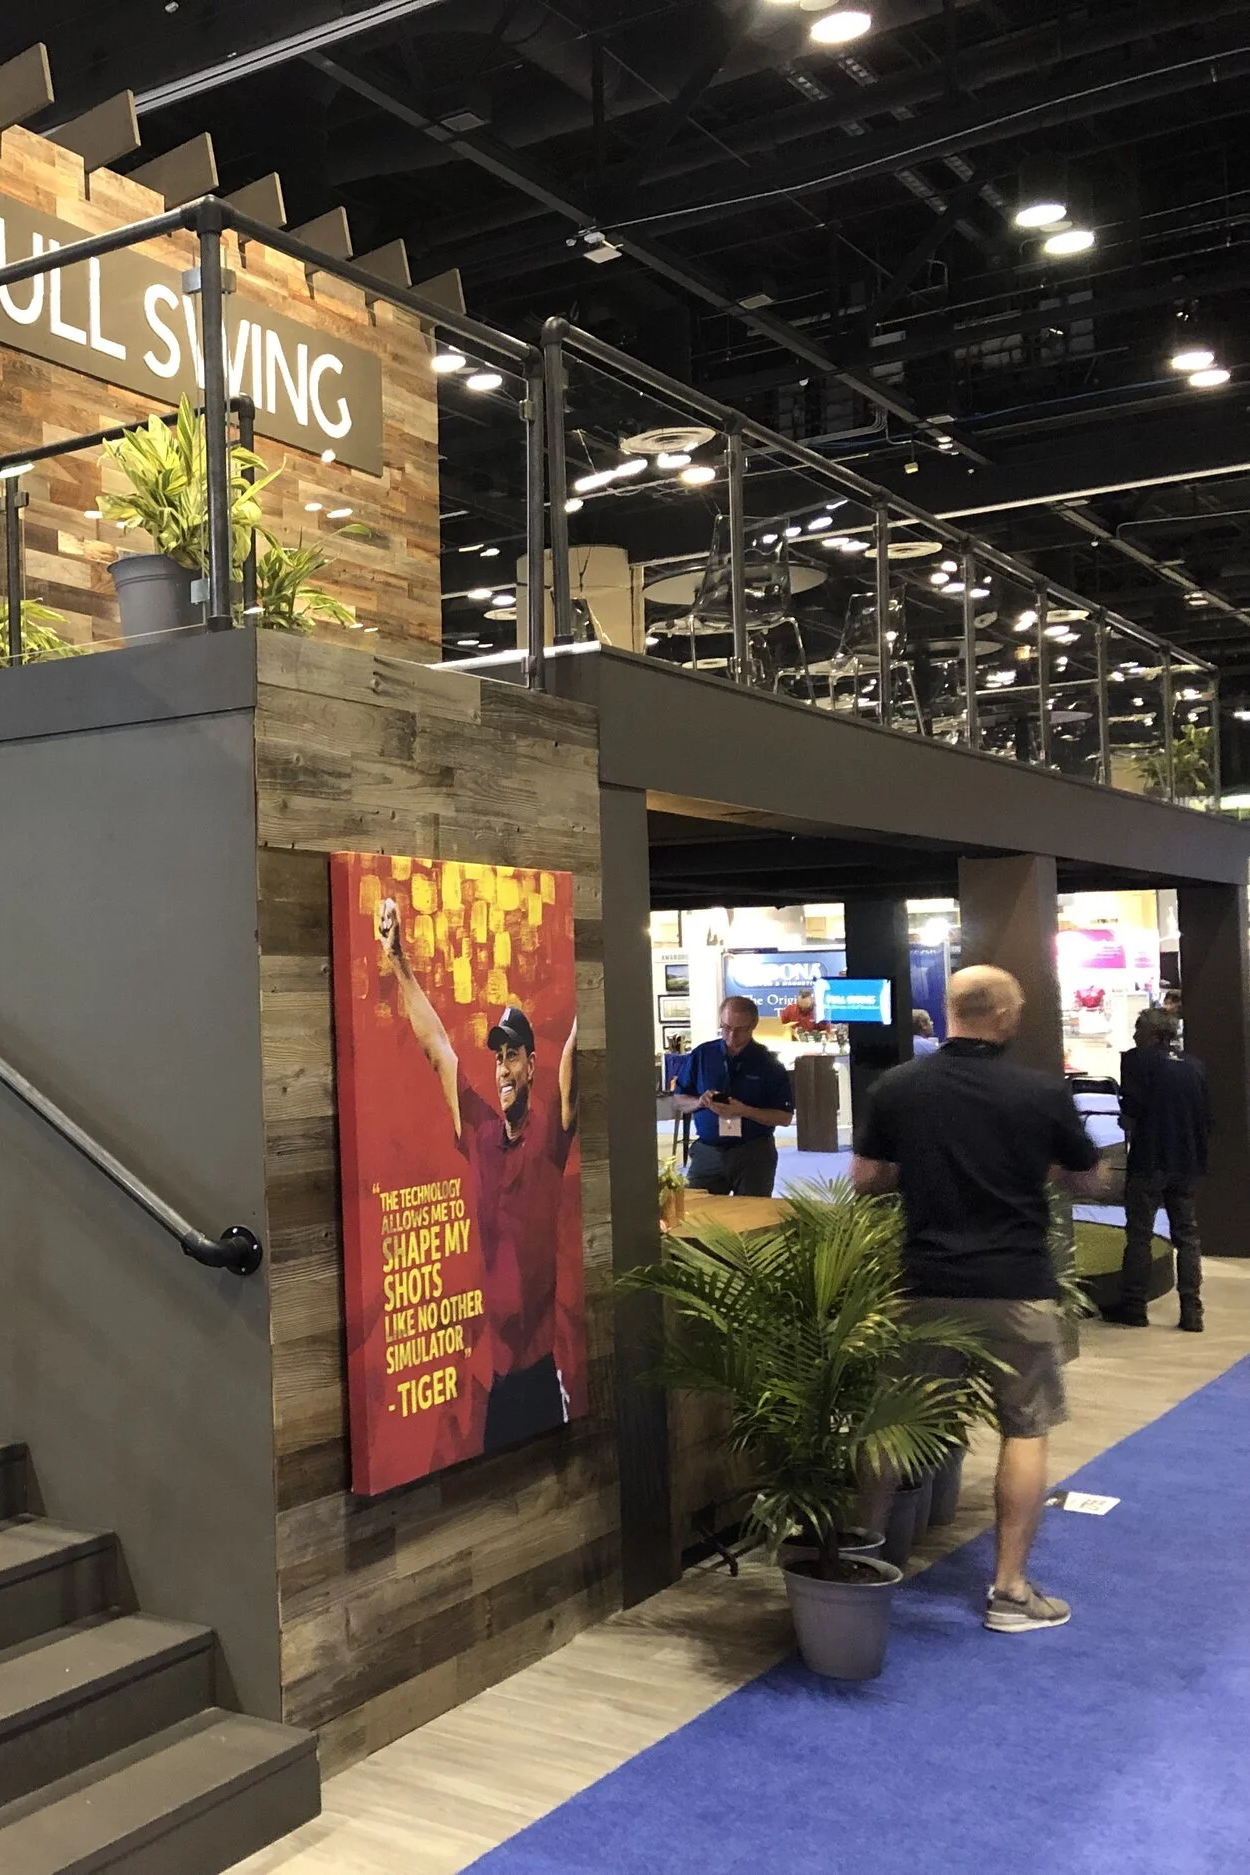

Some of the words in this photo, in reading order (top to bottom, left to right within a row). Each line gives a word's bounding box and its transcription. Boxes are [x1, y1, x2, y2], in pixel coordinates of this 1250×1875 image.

[143, 283, 352, 439] SWING
[381, 1207, 430, 1235] ALLOWS
[431, 1203, 449, 1225] ME
[449, 1199, 465, 1220] TO
[400, 1178, 461, 1209] TECHNOLOGY
[382, 1226, 441, 1273] SHAPE
[445, 1219, 471, 1258] MY
[383, 1262, 443, 1312] SHOTS
[385, 1308, 415, 1343] LIKE
[418, 1303, 438, 1333] NO
[440, 1289, 484, 1326] OTHER
